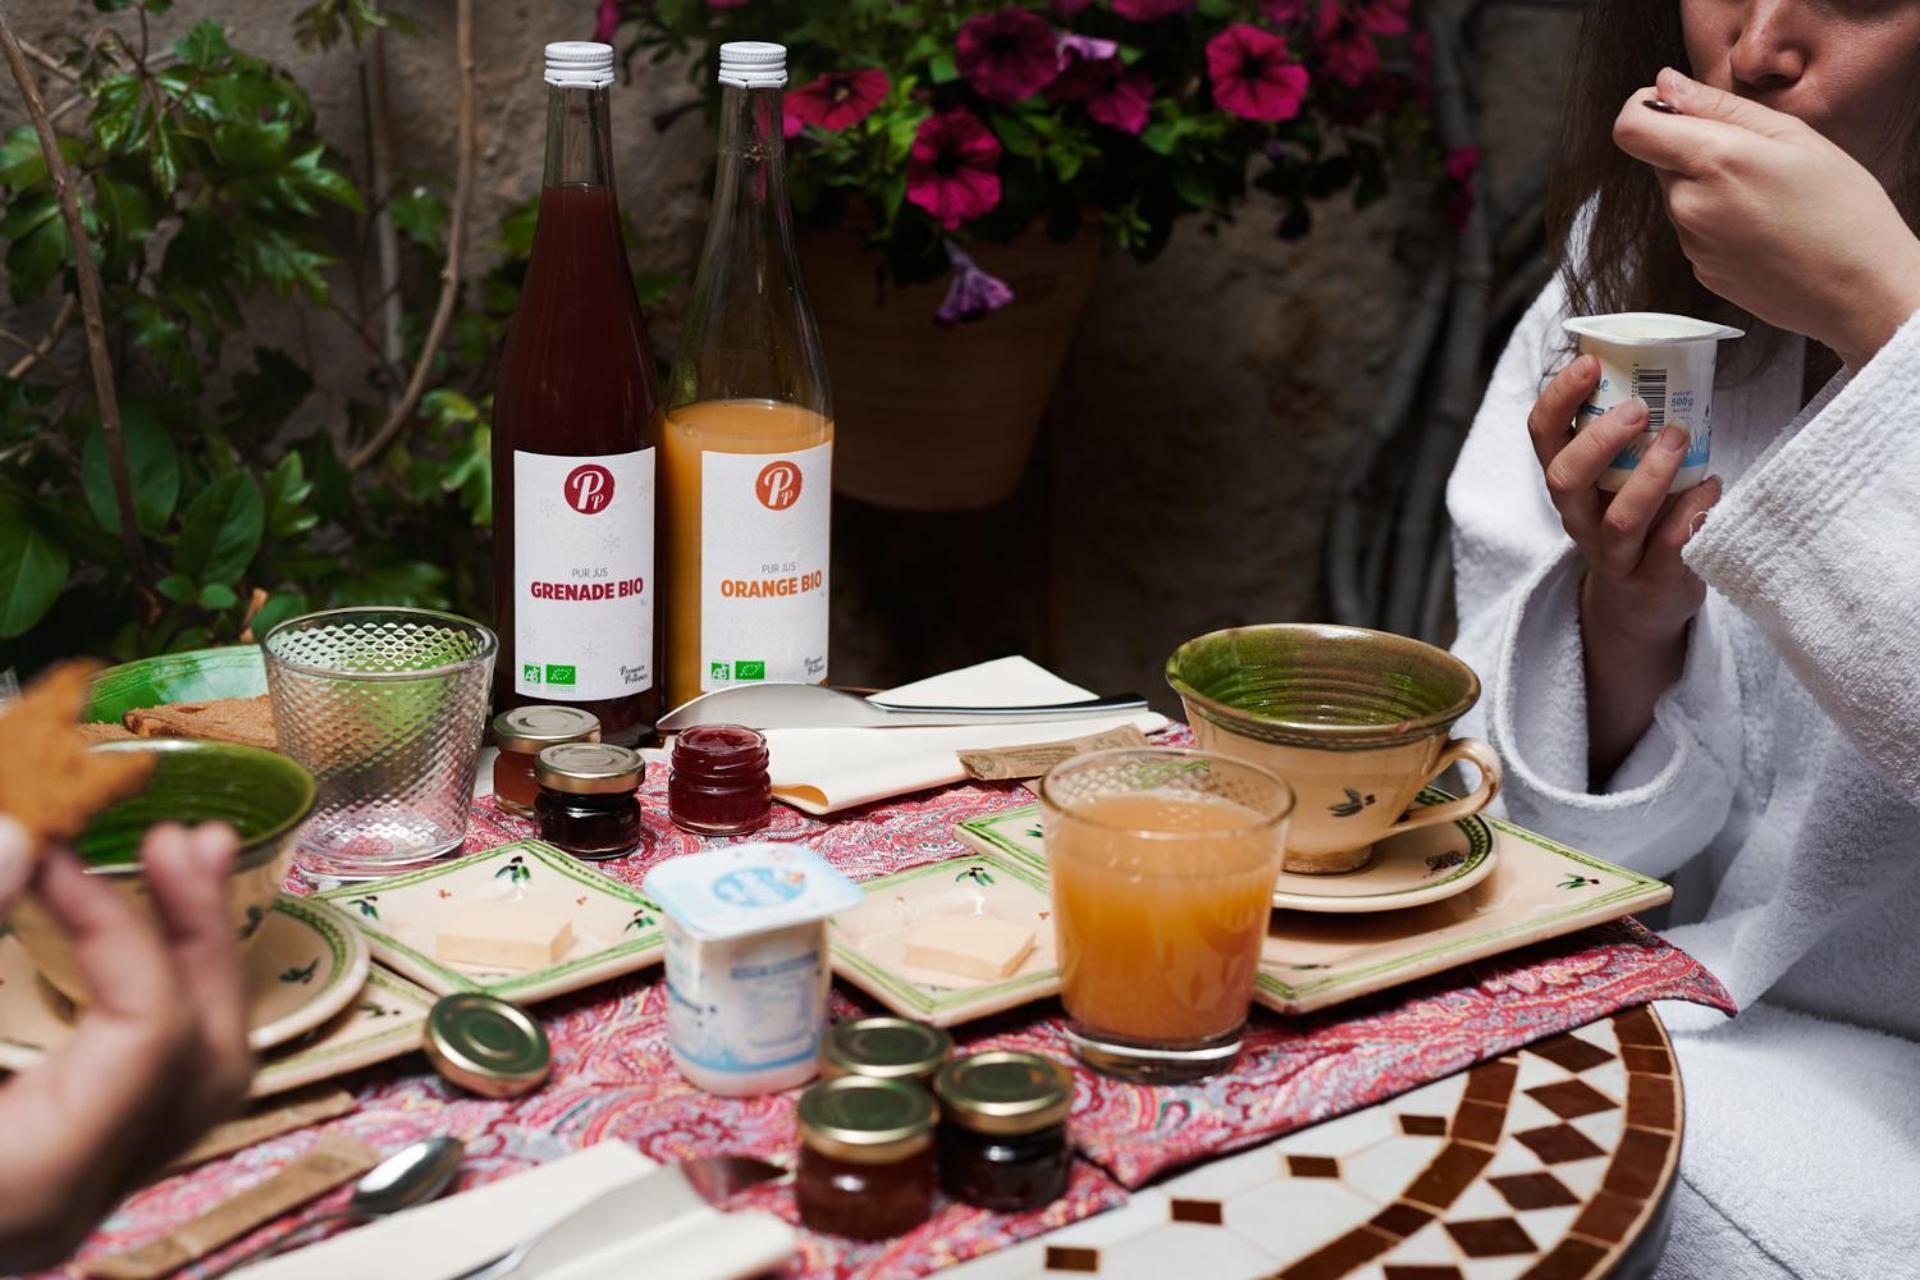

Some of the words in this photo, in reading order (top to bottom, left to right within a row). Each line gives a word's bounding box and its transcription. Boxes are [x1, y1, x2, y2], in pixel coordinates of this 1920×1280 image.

[572, 568, 590, 577] PUR
[593, 567, 608, 577] JUS
[762, 564, 779, 573] PUR
[782, 562, 796, 572] JUS
[531, 581, 614, 601] GRENADE
[618, 577, 643, 597] BIO
[721, 578, 797, 597] ORANGE
[801, 569, 822, 592] BIO
